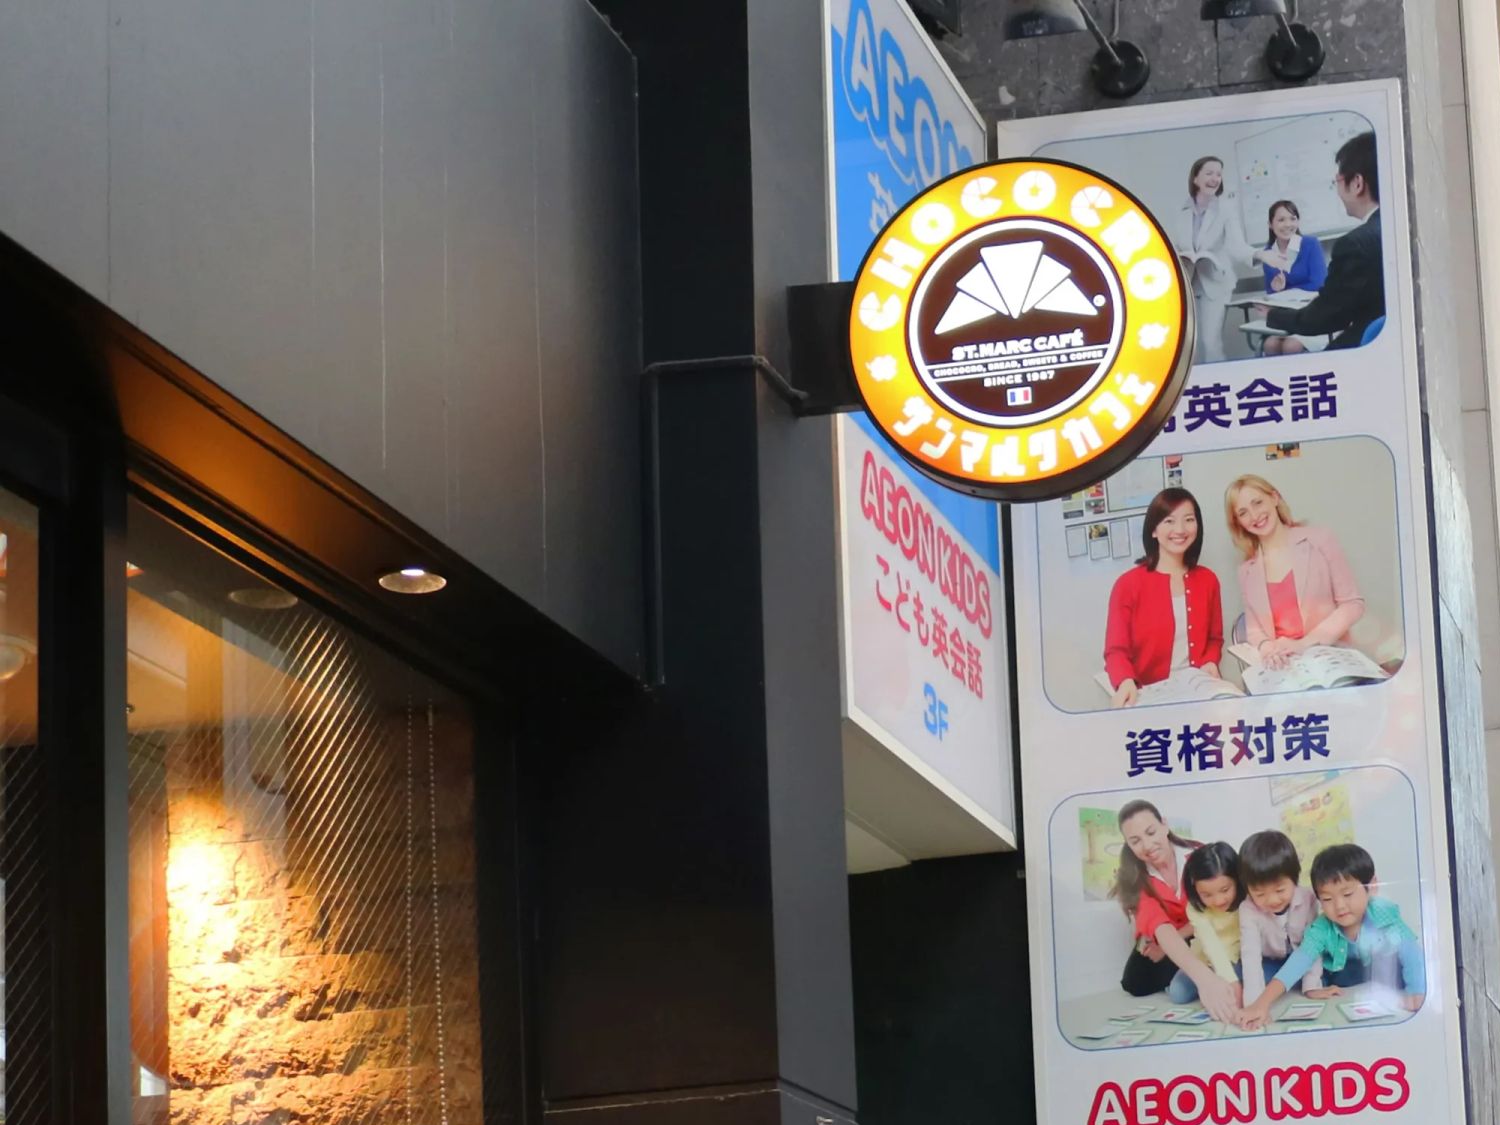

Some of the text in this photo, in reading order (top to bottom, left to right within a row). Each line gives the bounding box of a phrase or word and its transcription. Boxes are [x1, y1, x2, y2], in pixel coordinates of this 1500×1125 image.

[859, 170, 1172, 330] CHOCOCRO
[983, 373, 1023, 387] SINCE
[1160, 371, 1338, 434] 英会話
[891, 371, 1155, 477] サンマルクカフェ
[861, 450, 993, 640] AEON KIDS
[874, 554, 985, 700] こども英会話
[922, 681, 950, 743] 3F
[1124, 712, 1331, 778] 資格対策
[1262, 1057, 1411, 1123] KIDS
